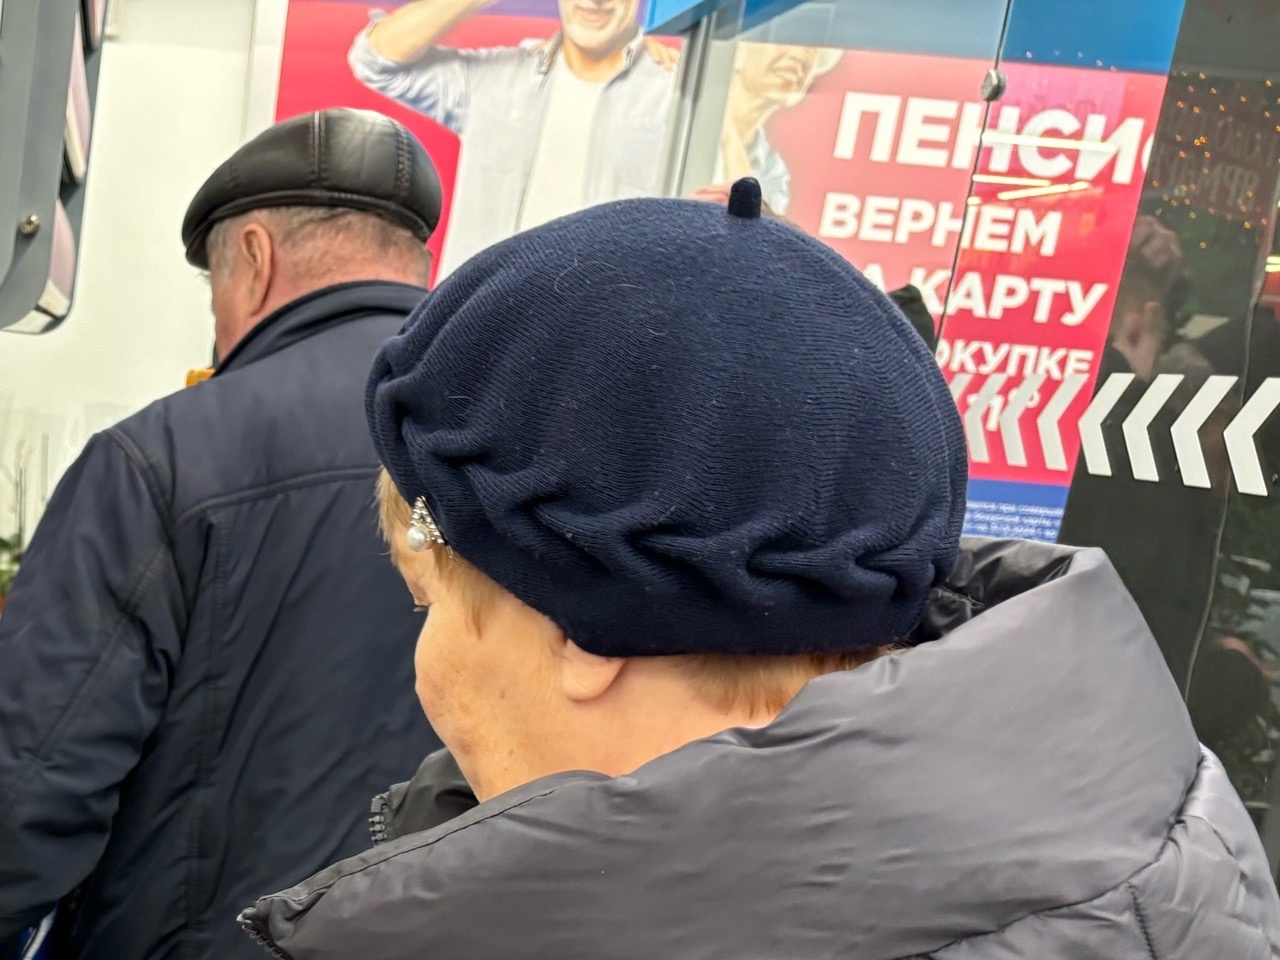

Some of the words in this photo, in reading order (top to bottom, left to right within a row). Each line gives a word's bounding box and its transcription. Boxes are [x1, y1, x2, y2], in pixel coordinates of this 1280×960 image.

[834, 92, 1153, 185] ПЕНСИ
[909, 267, 1107, 326] КАРТУ
[935, 338, 1094, 381] ОКУПКЕ
